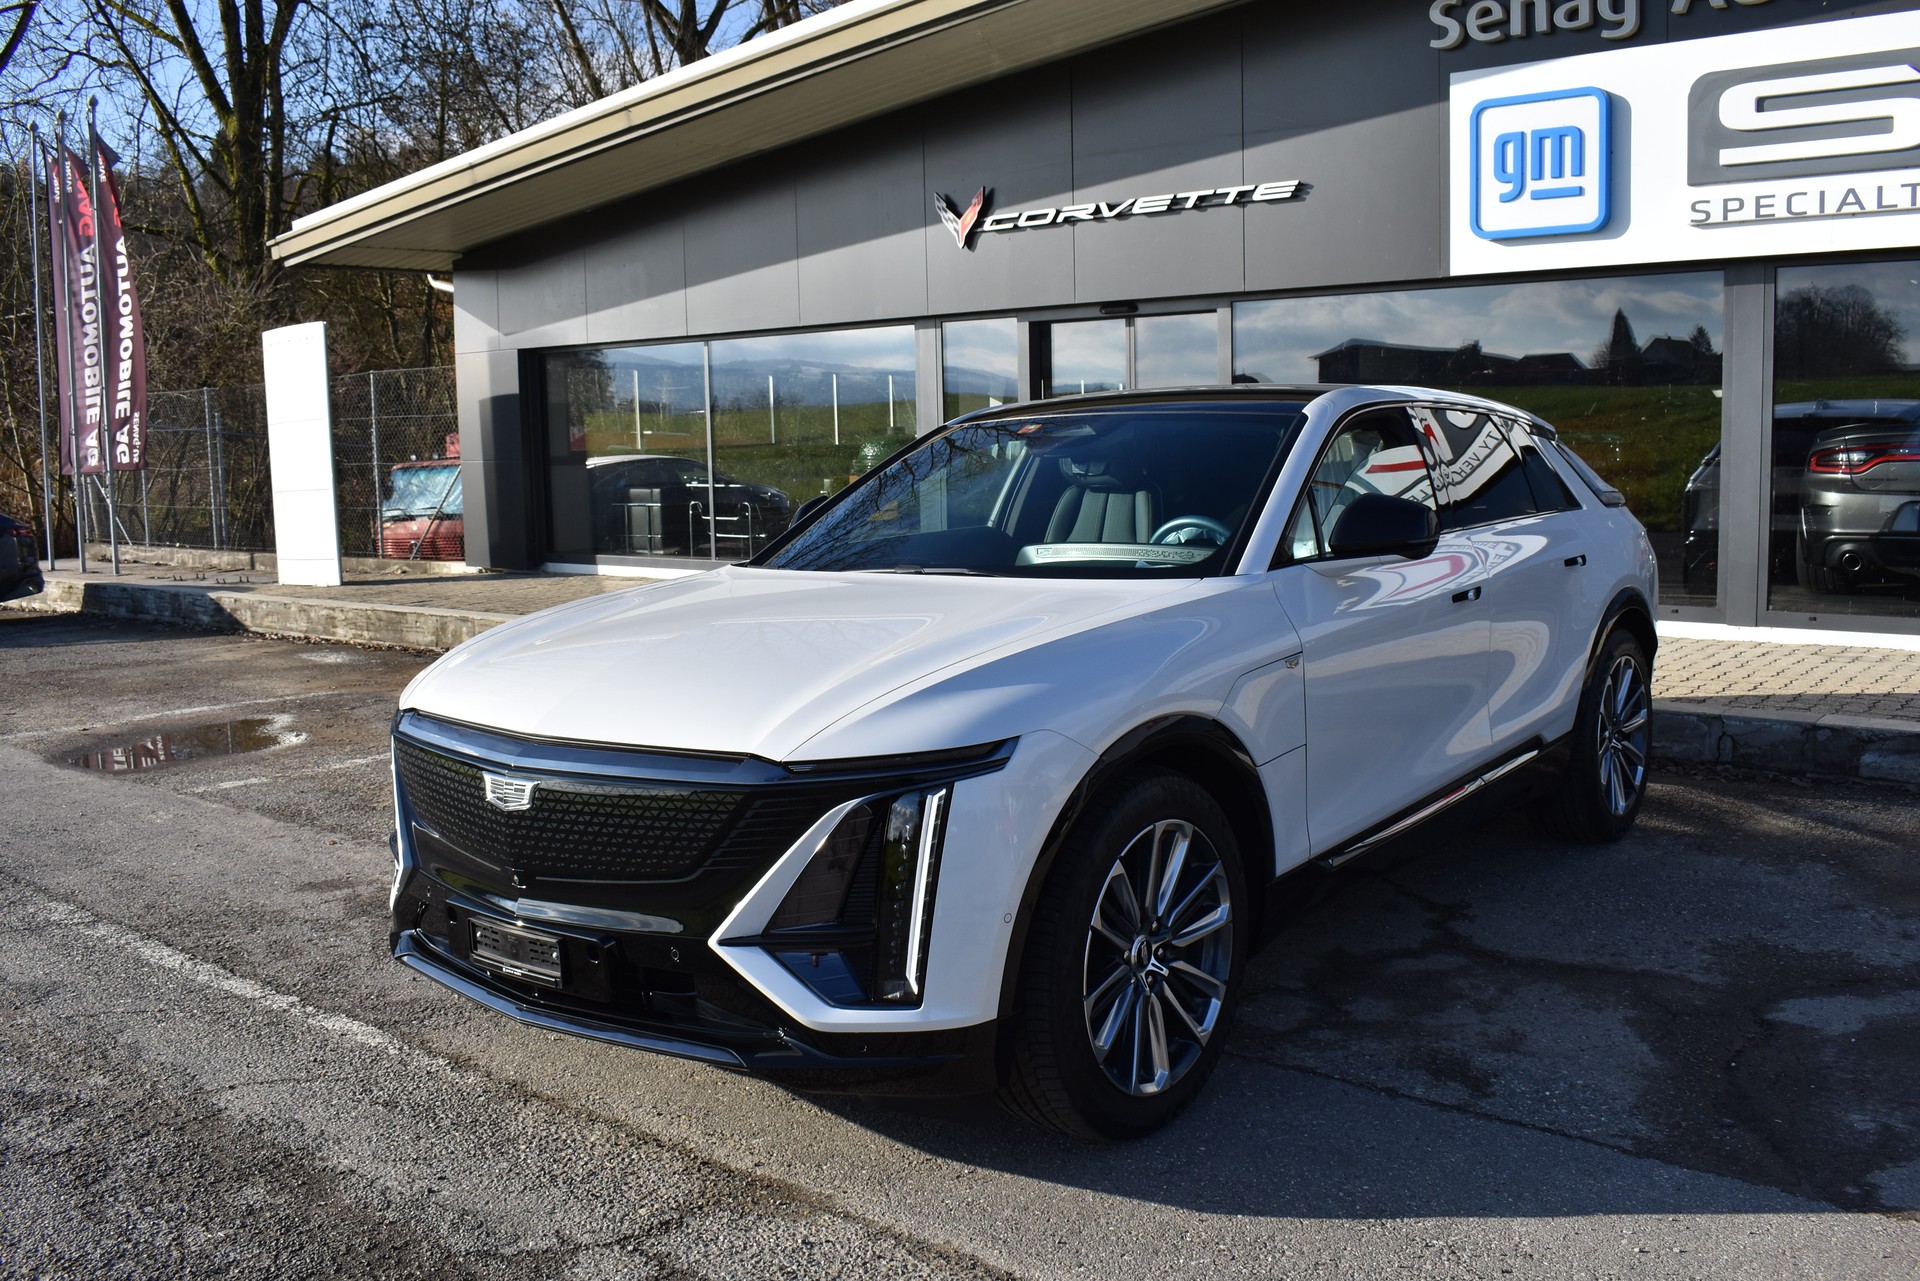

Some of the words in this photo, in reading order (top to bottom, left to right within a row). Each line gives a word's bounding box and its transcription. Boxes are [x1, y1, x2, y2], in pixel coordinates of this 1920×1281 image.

[1493, 125, 1586, 203] gm
[982, 179, 1301, 233] CORVETTE
[1690, 182, 1920, 224] SPECIALT
